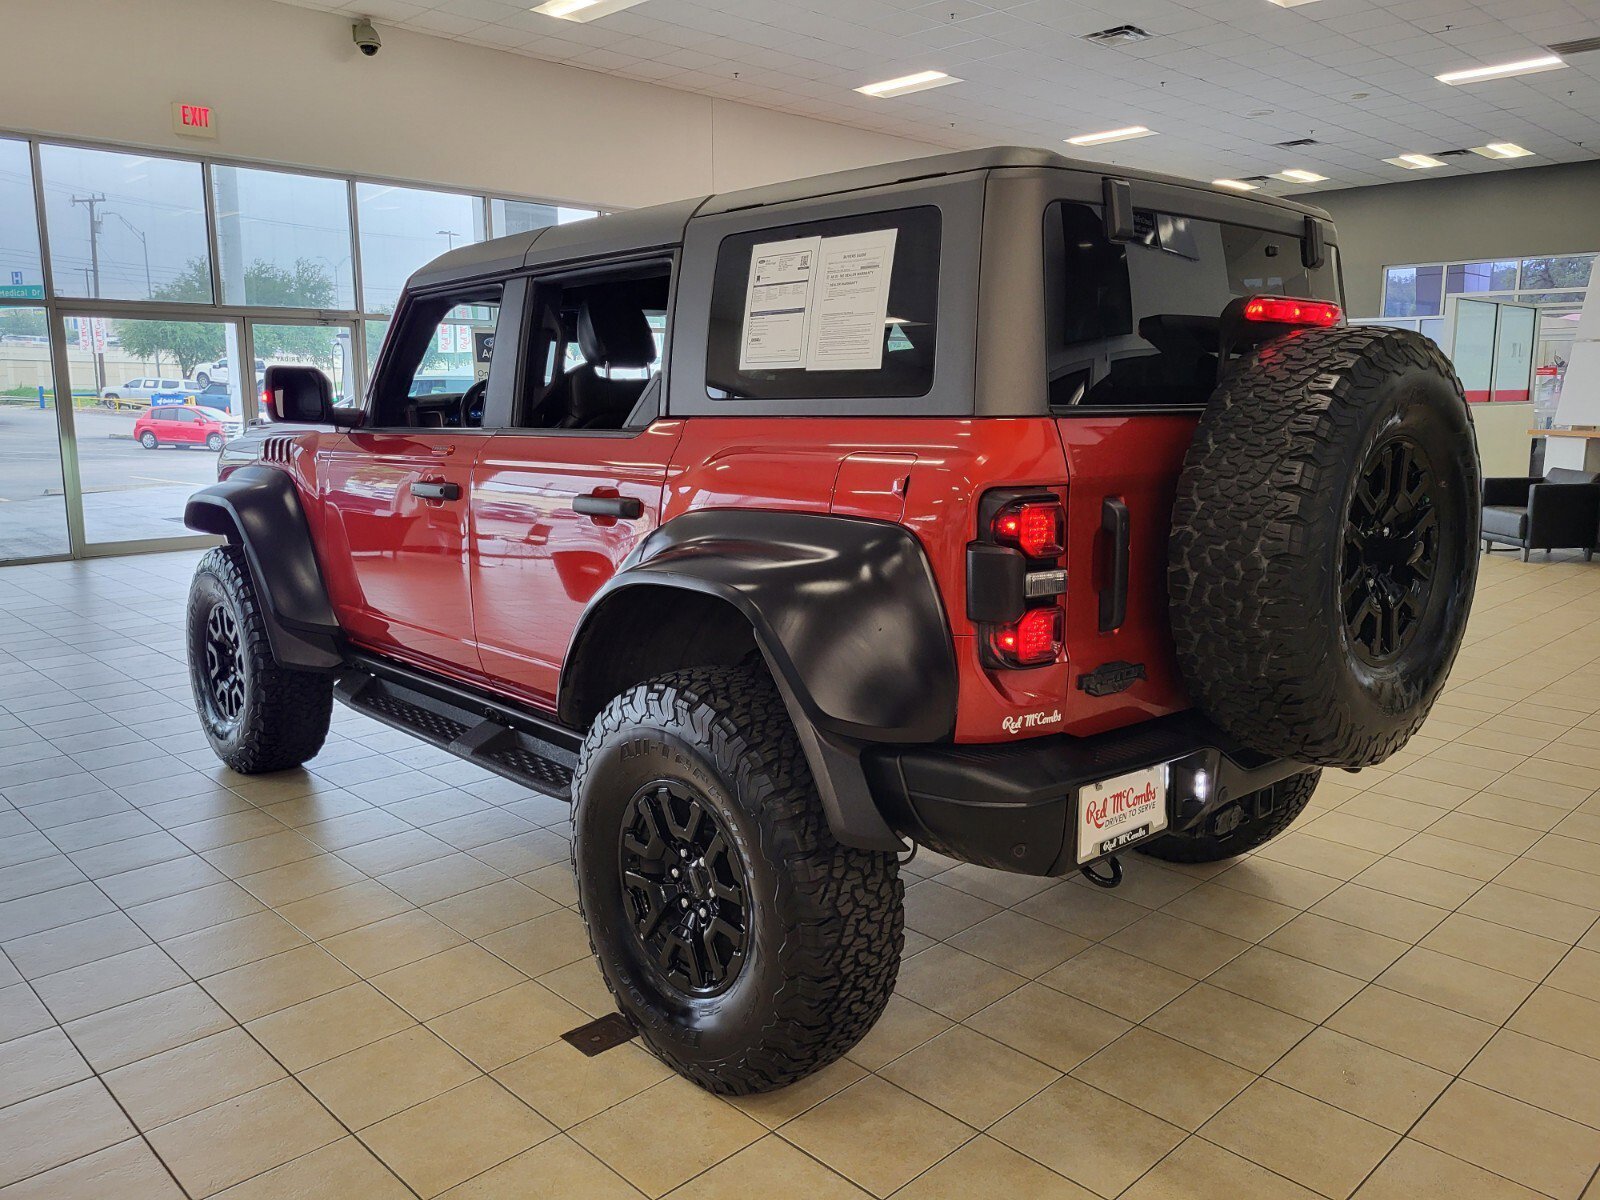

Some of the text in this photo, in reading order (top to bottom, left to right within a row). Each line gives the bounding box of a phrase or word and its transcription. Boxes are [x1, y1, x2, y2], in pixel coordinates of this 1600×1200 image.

[182, 105, 209, 128] EXIT
[1002, 709, 1062, 735] Red McCombs
[1086, 782, 1157, 829] Red McCombs
[1104, 801, 1157, 828] DRIVEN TO SERVE
[1103, 828, 1147, 852] Red McCombs
